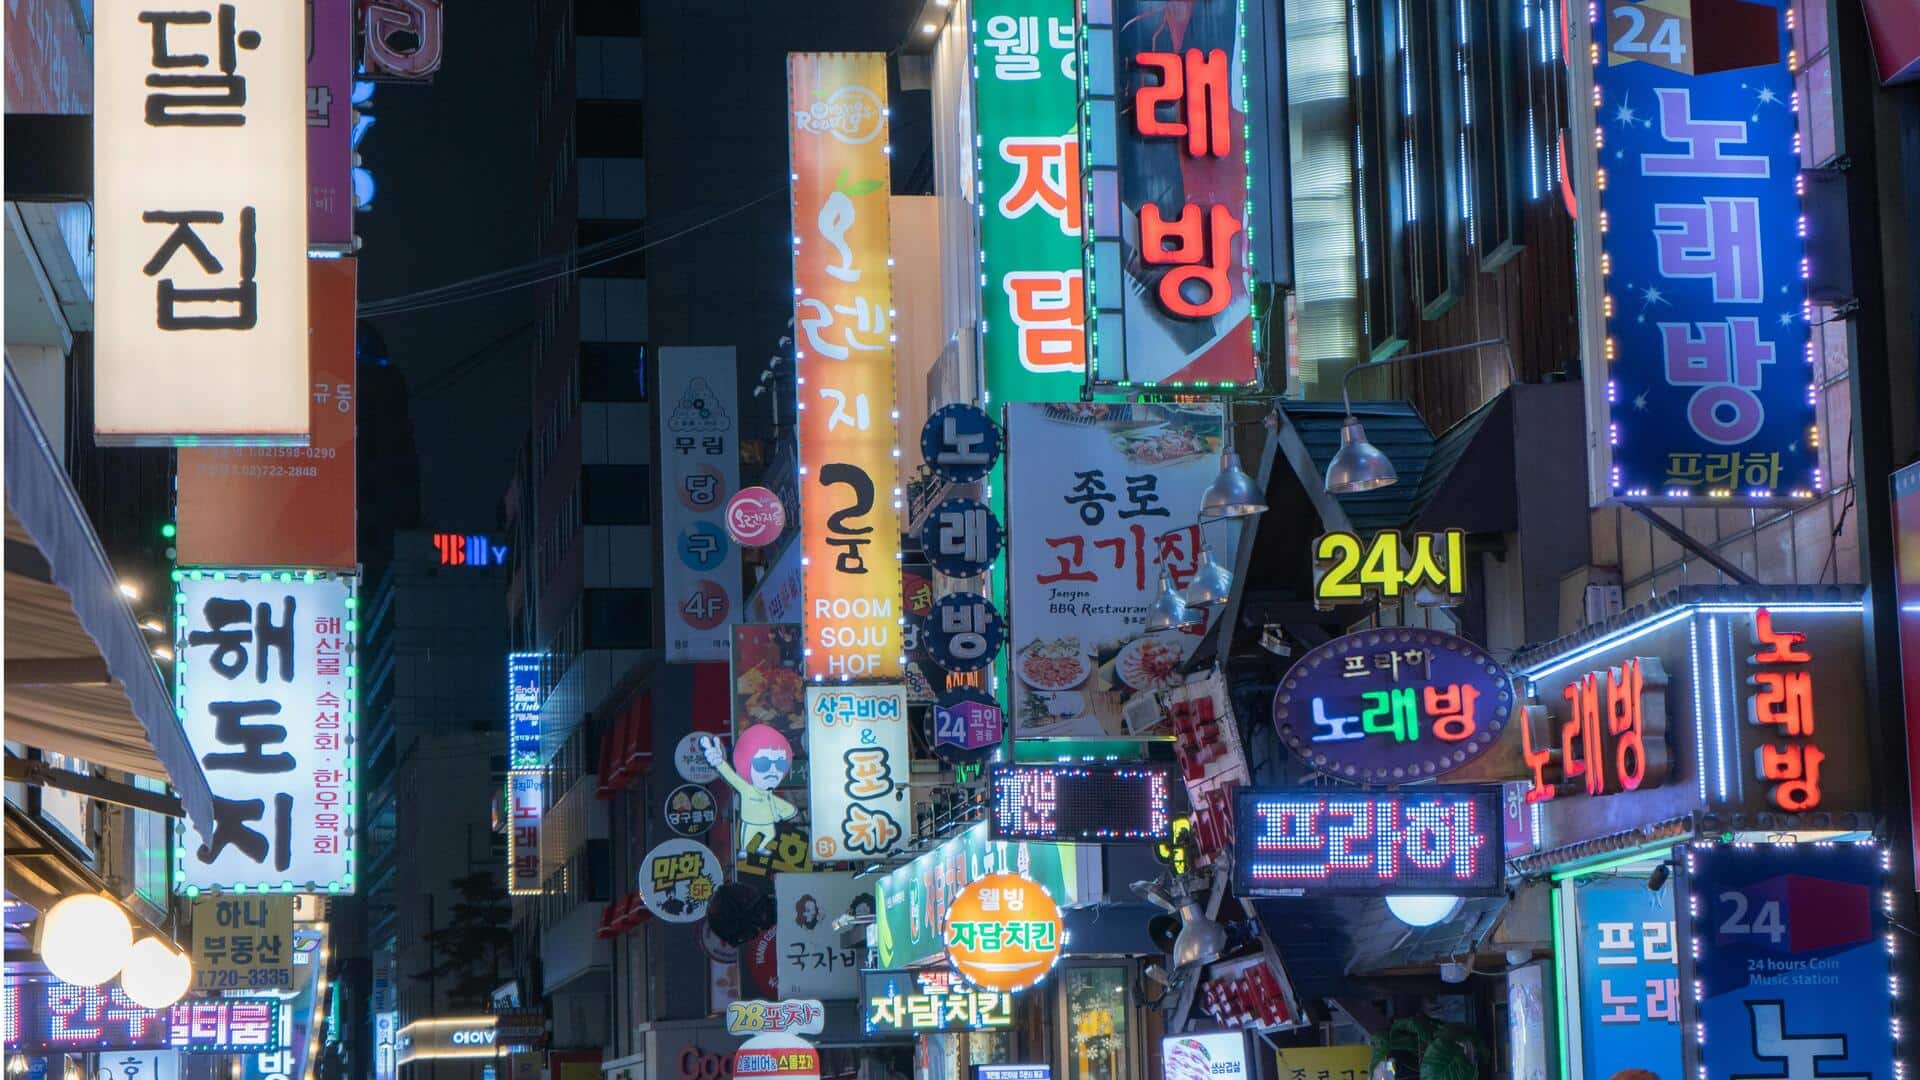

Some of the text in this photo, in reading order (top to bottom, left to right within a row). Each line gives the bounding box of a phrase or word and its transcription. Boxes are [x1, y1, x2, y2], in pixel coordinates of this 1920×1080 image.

[1613, 5, 1686, 65] 24
[1640, 87, 1777, 446] 노래방
[1663, 451, 1783, 489] 프라하
[1064, 470, 1171, 526] 종로
[937, 416, 992, 659] 노래방
[1318, 532, 1462, 598] 24시
[685, 591, 723, 619] 4F
[815, 598, 892, 619] ROOM
[1049, 603, 1076, 616] BBQ
[820, 627, 888, 648] SOJU
[828, 654, 881, 675] HOF
[1343, 649, 1436, 682] 프라하
[815, 694, 901, 725] 상구비어
[970, 709, 997, 728] 코인
[1312, 683, 1481, 743] 노래방
[1752, 607, 1825, 813] 노래방
[189, 595, 298, 873] 해도지
[938, 711, 966, 743] 24
[1520, 656, 1647, 805] 노래방
[842, 747, 902, 854] 포차
[1252, 800, 1486, 879] 프라하
[653, 851, 704, 891] 만화
[693, 884, 709, 896] 5F
[978, 888, 1025, 912] 웰빙
[216, 901, 268, 929] 하나
[1719, 891, 1786, 944] 24
[203, 935, 282, 965] 부동산
[950, 921, 1056, 951] 자담치킨
[1747, 957, 1840, 972] 24 hours Coin
[1750, 973, 1840, 987] Music station
[729, 1003, 820, 1032] 28포차
[871, 994, 1011, 1029] 자담치킨
